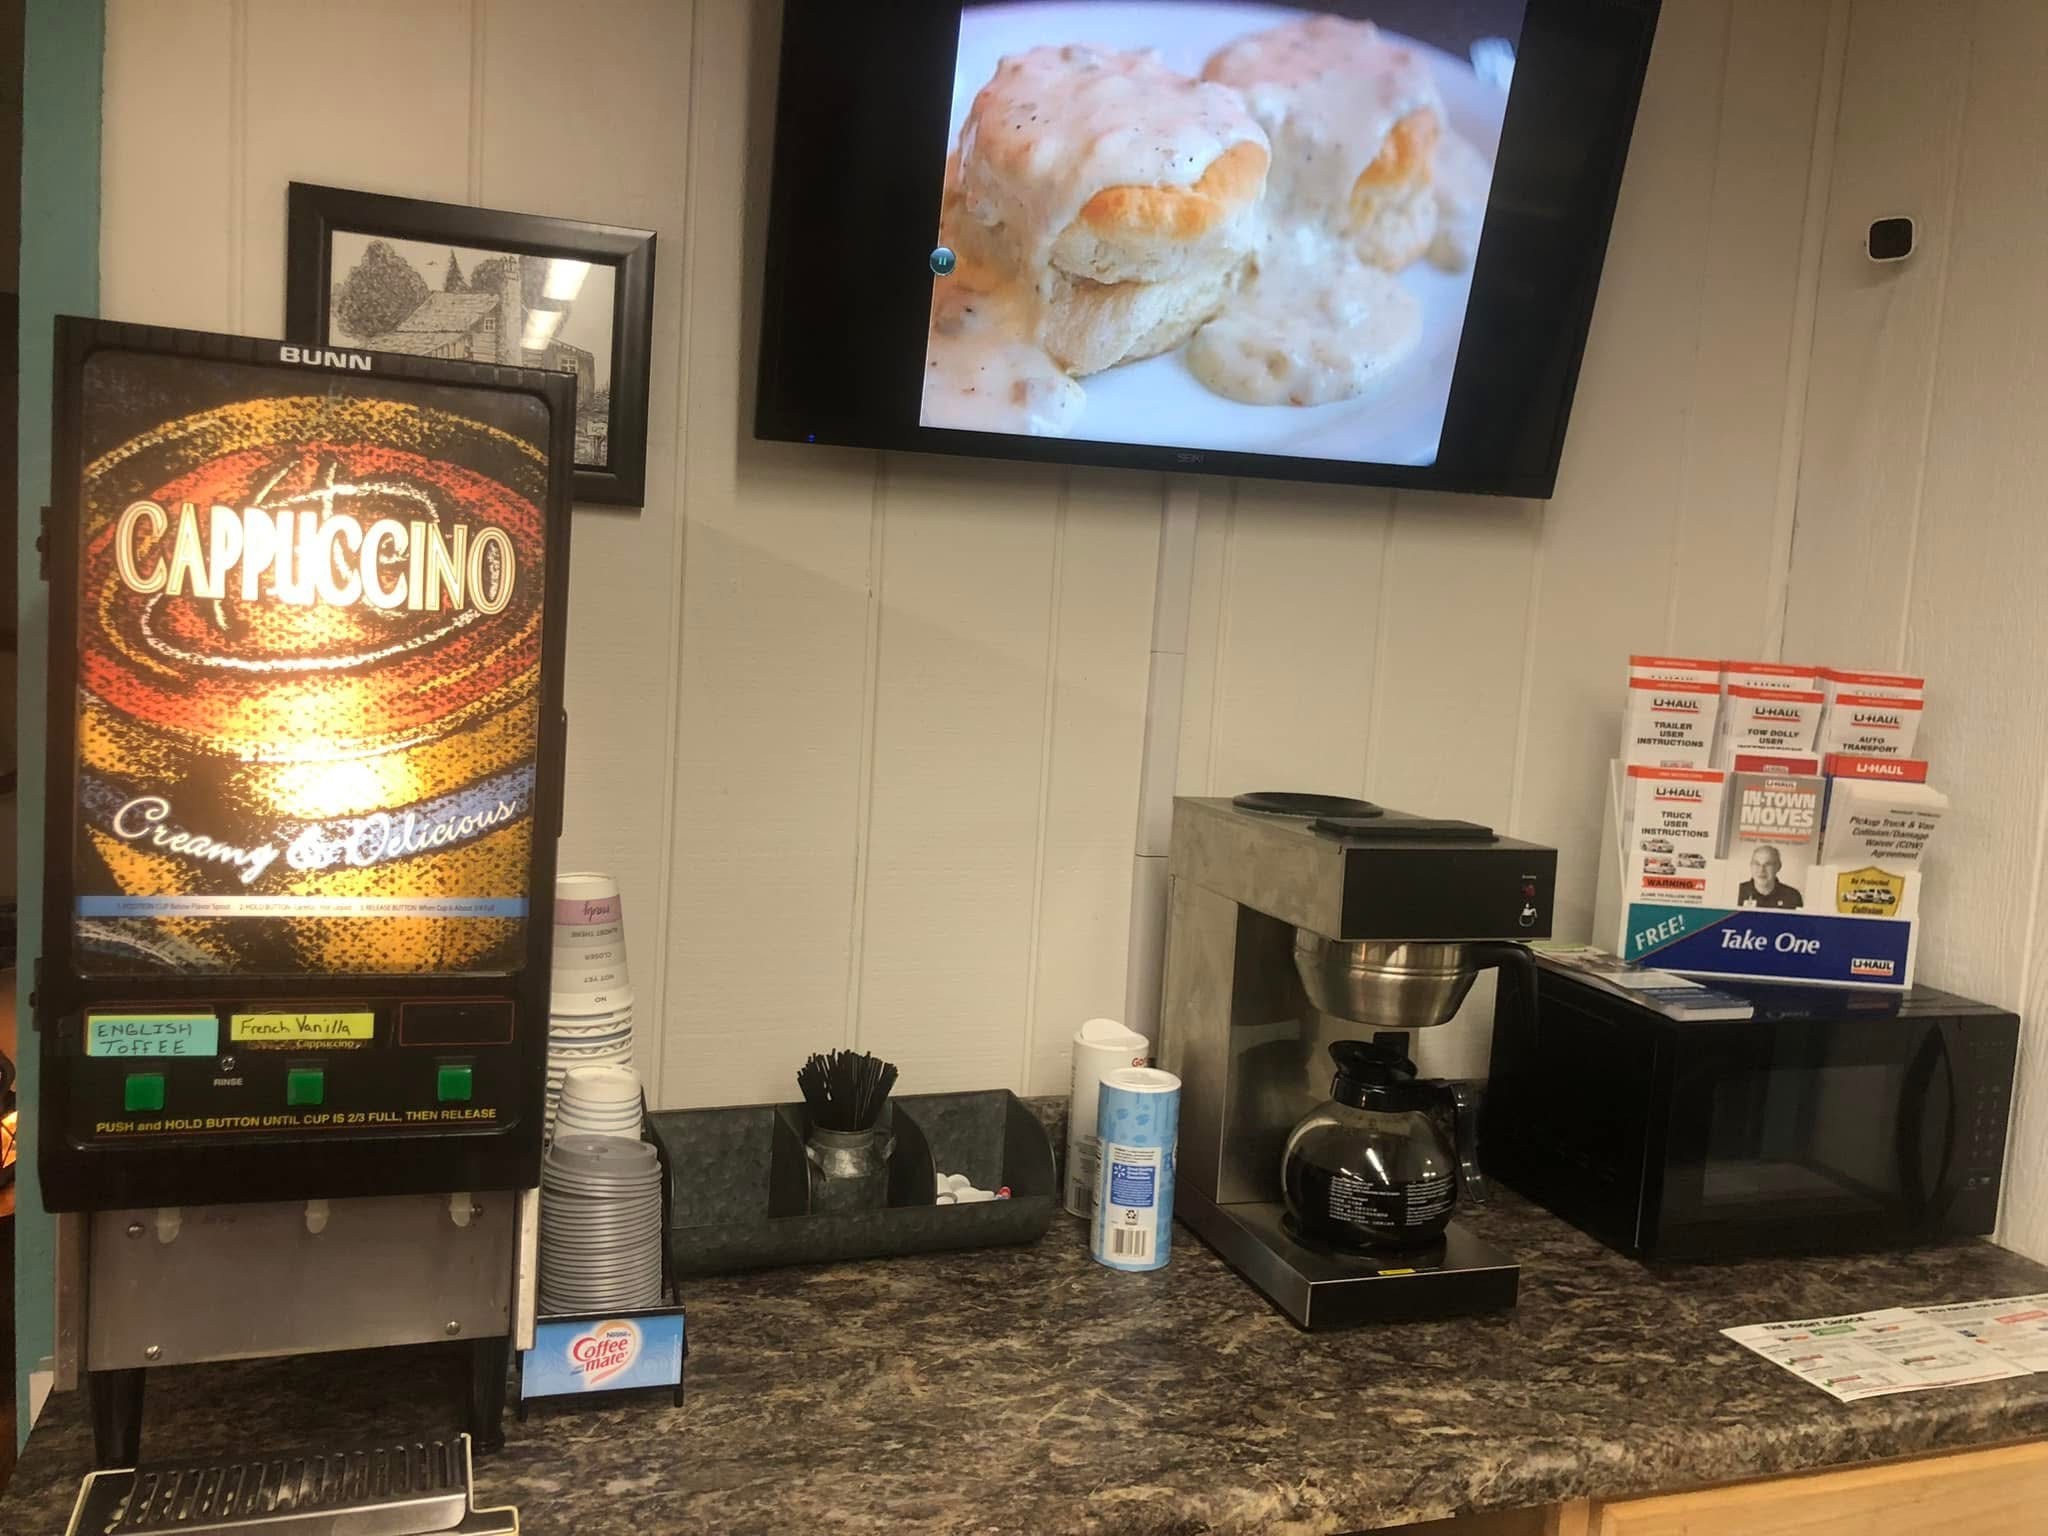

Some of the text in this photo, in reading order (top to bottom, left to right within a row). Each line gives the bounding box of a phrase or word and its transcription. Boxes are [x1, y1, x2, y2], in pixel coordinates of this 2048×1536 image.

[280, 346, 372, 371] BUNN
[115, 500, 516, 614] CAPPUCCINO
[1653, 698, 1699, 709] U-HAUL
[1755, 706, 1800, 718] U-HAUL
[1854, 713, 1900, 725] U-HAUL
[1654, 721, 1692, 730] TRAILER
[1660, 730, 1684, 738] USER
[1747, 728, 1800, 738] TOW DOLLY
[1637, 737, 1704, 748] INSTRUCTIONS
[1759, 737, 1784, 745] USER
[1859, 736, 1885, 744] AUTO
[1843, 743, 1898, 753] TRANSPORT
[1856, 762, 1904, 775] U-HAUL
[1656, 787, 1702, 798] U-HAUL
[1743, 790, 1816, 809] IN-TOWN
[1661, 811, 1692, 819] TRUCK
[1740, 806, 1814, 828] MOVES
[1663, 820, 1689, 828] USER
[1850, 816, 1936, 830] Pickup Truck & Van
[1641, 828, 1709, 838] INSTRUCTIONS
[1852, 828, 1929, 841] Collision/Damage
[113, 796, 280, 885] Creamy
[335, 800, 518, 867] Delicious
[1865, 840, 1895, 848] Waiver
[1871, 849, 1919, 860] Agreement
[1647, 879, 1694, 889] WARNING
[1634, 914, 1686, 951] FREE!
[1721, 928, 1821, 954] Take One
[584, 951, 612, 961] CLOSER
[1853, 959, 1893, 970] U-HAUL
[97, 1022, 193, 1036] ENGLISH
[240, 1017, 352, 1035] French Vanilla
[296, 1040, 356, 1050] Cappuccino
[213, 1077, 244, 1087] RINSE
[96, 1108, 497, 1132] PUSH and HOLD BUTTON UNTIL CUP IS 2/3 FULL, THEN RELEASE
[573, 1336, 629, 1363] Coffee
[585, 1353, 625, 1372] mate
